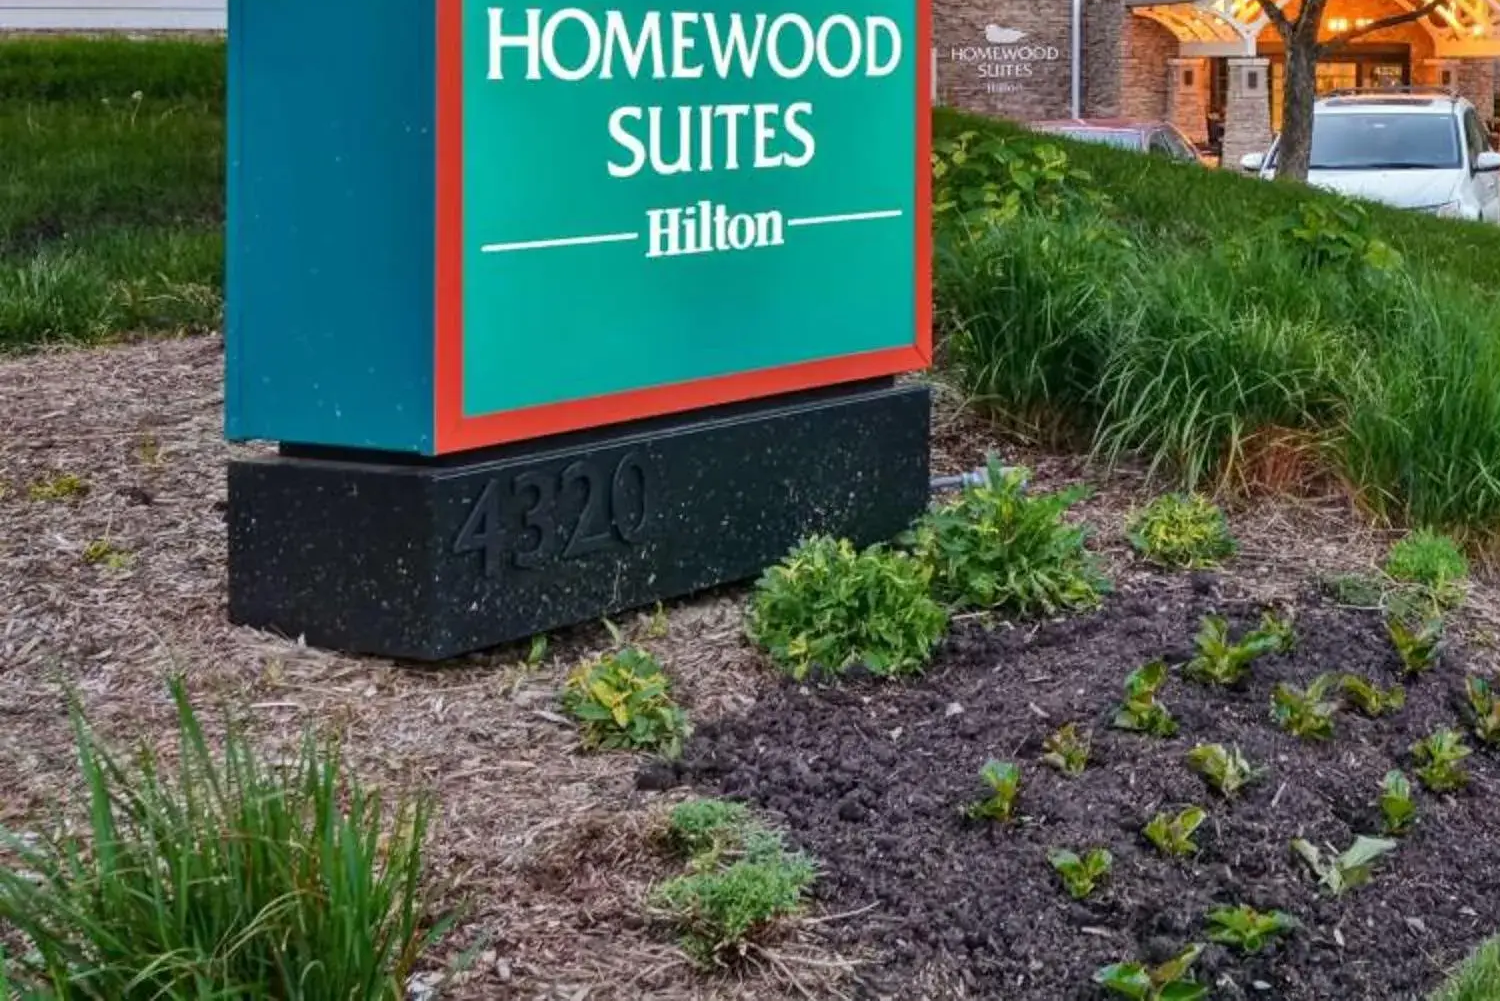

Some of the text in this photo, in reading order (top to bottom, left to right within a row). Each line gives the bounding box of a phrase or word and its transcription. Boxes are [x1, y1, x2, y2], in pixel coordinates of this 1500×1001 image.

[486, 6, 902, 80] HOMEWOOD
[951, 46, 1059, 60] HOMEWOOD
[978, 62, 1032, 78] SUITES
[606, 101, 815, 178] SUITES
[645, 200, 785, 258] Hilton
[453, 450, 649, 577] 4320
